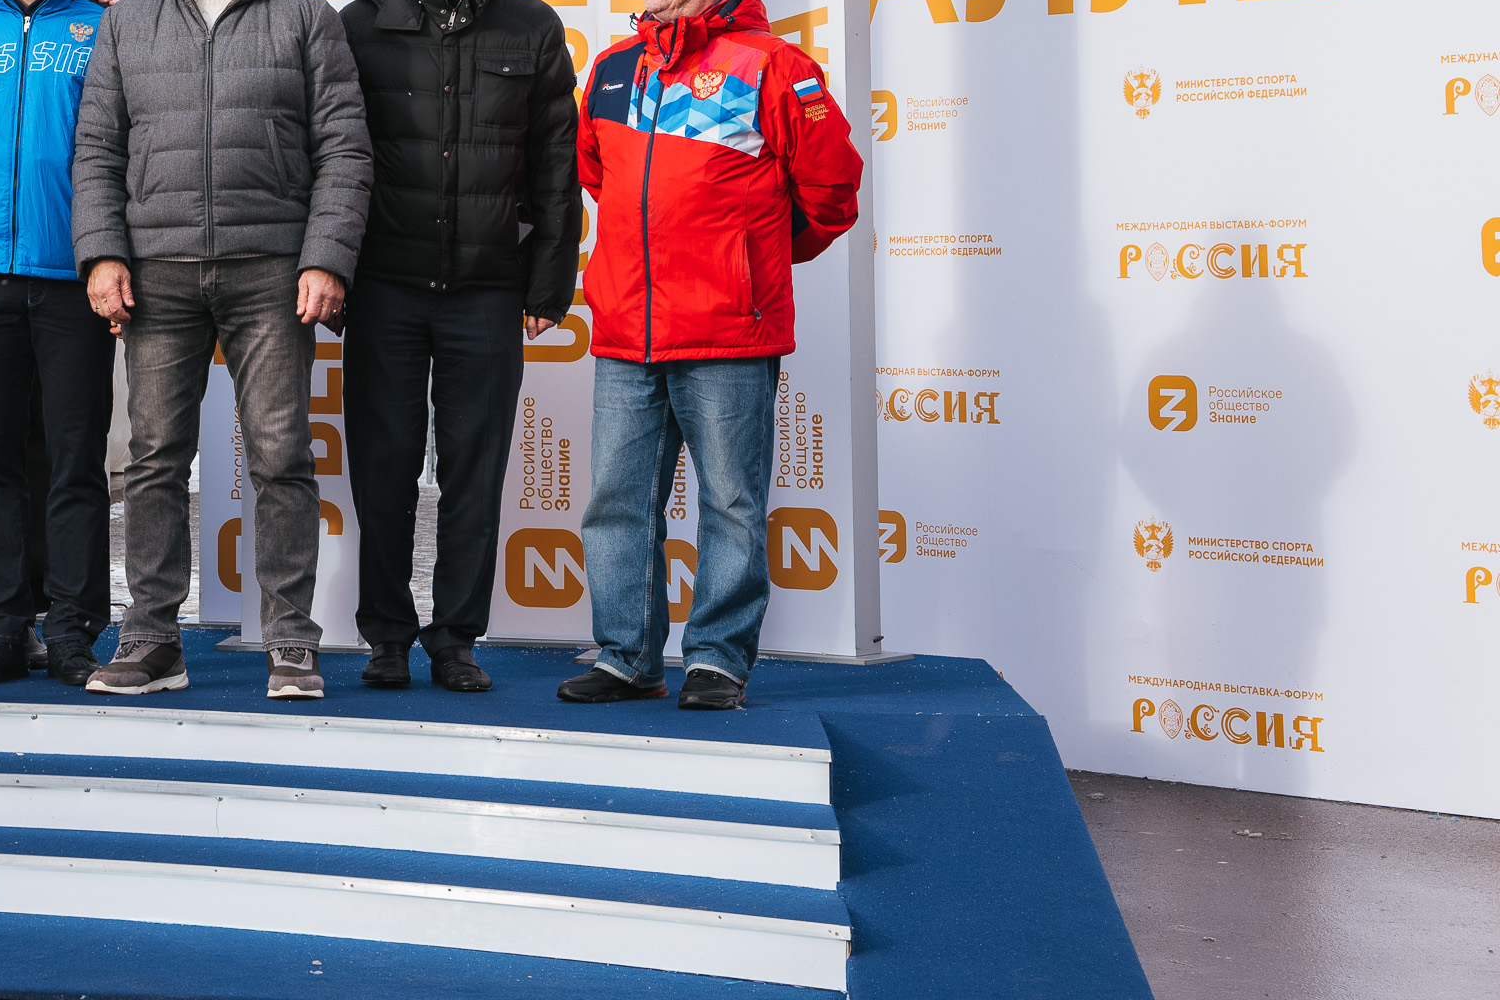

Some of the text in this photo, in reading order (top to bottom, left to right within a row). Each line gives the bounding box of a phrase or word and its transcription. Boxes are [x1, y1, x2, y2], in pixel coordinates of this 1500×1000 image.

[1175, 74, 1297, 89] МИНИСТЕРСТВО СПОРТА
[906, 95, 970, 109] Российское
[1176, 87, 1308, 103] РОССИЙСКОЙ ФЕДЕРАЦИИ
[907, 108, 958, 121] общество
[907, 120, 947, 132] Знание
[1116, 218, 1308, 233] МЕЖДУНАРОДНАЯ ВЫСТАВКА-ФОРУМ
[888, 234, 994, 245] МИНИСТЕРСТВО СПОРТА
[889, 245, 1002, 257] РОССИЙСКОЙ ФЕДЕРАЦИИ
[917, 367, 1001, 379] ВЫСТАВКА-ФОРУМ
[1208, 385, 1283, 400] Российское
[1208, 398, 1271, 413] общество
[1209, 410, 1257, 425] Знание
[774, 370, 792, 489] Российское
[230, 394, 243, 501] Российск
[791, 390, 810, 490] общество
[518, 396, 537, 511] Российское
[808, 412, 825, 491] Знание
[536, 416, 557, 512] общество
[553, 437, 571, 512] Знание
[915, 520, 979, 537] Российское
[915, 534, 968, 548] общество
[1188, 536, 1314, 553] МИНИСТЕРСТВО СПОРТА
[915, 544, 957, 559] Знание
[1188, 549, 1325, 568] РОССИЙСКОЙ ФЕДЕРАЦИИ
[1128, 674, 1325, 703] МЕЖДУНАРОДНАЯ ВЫСТАВКА-ФОРУМ
